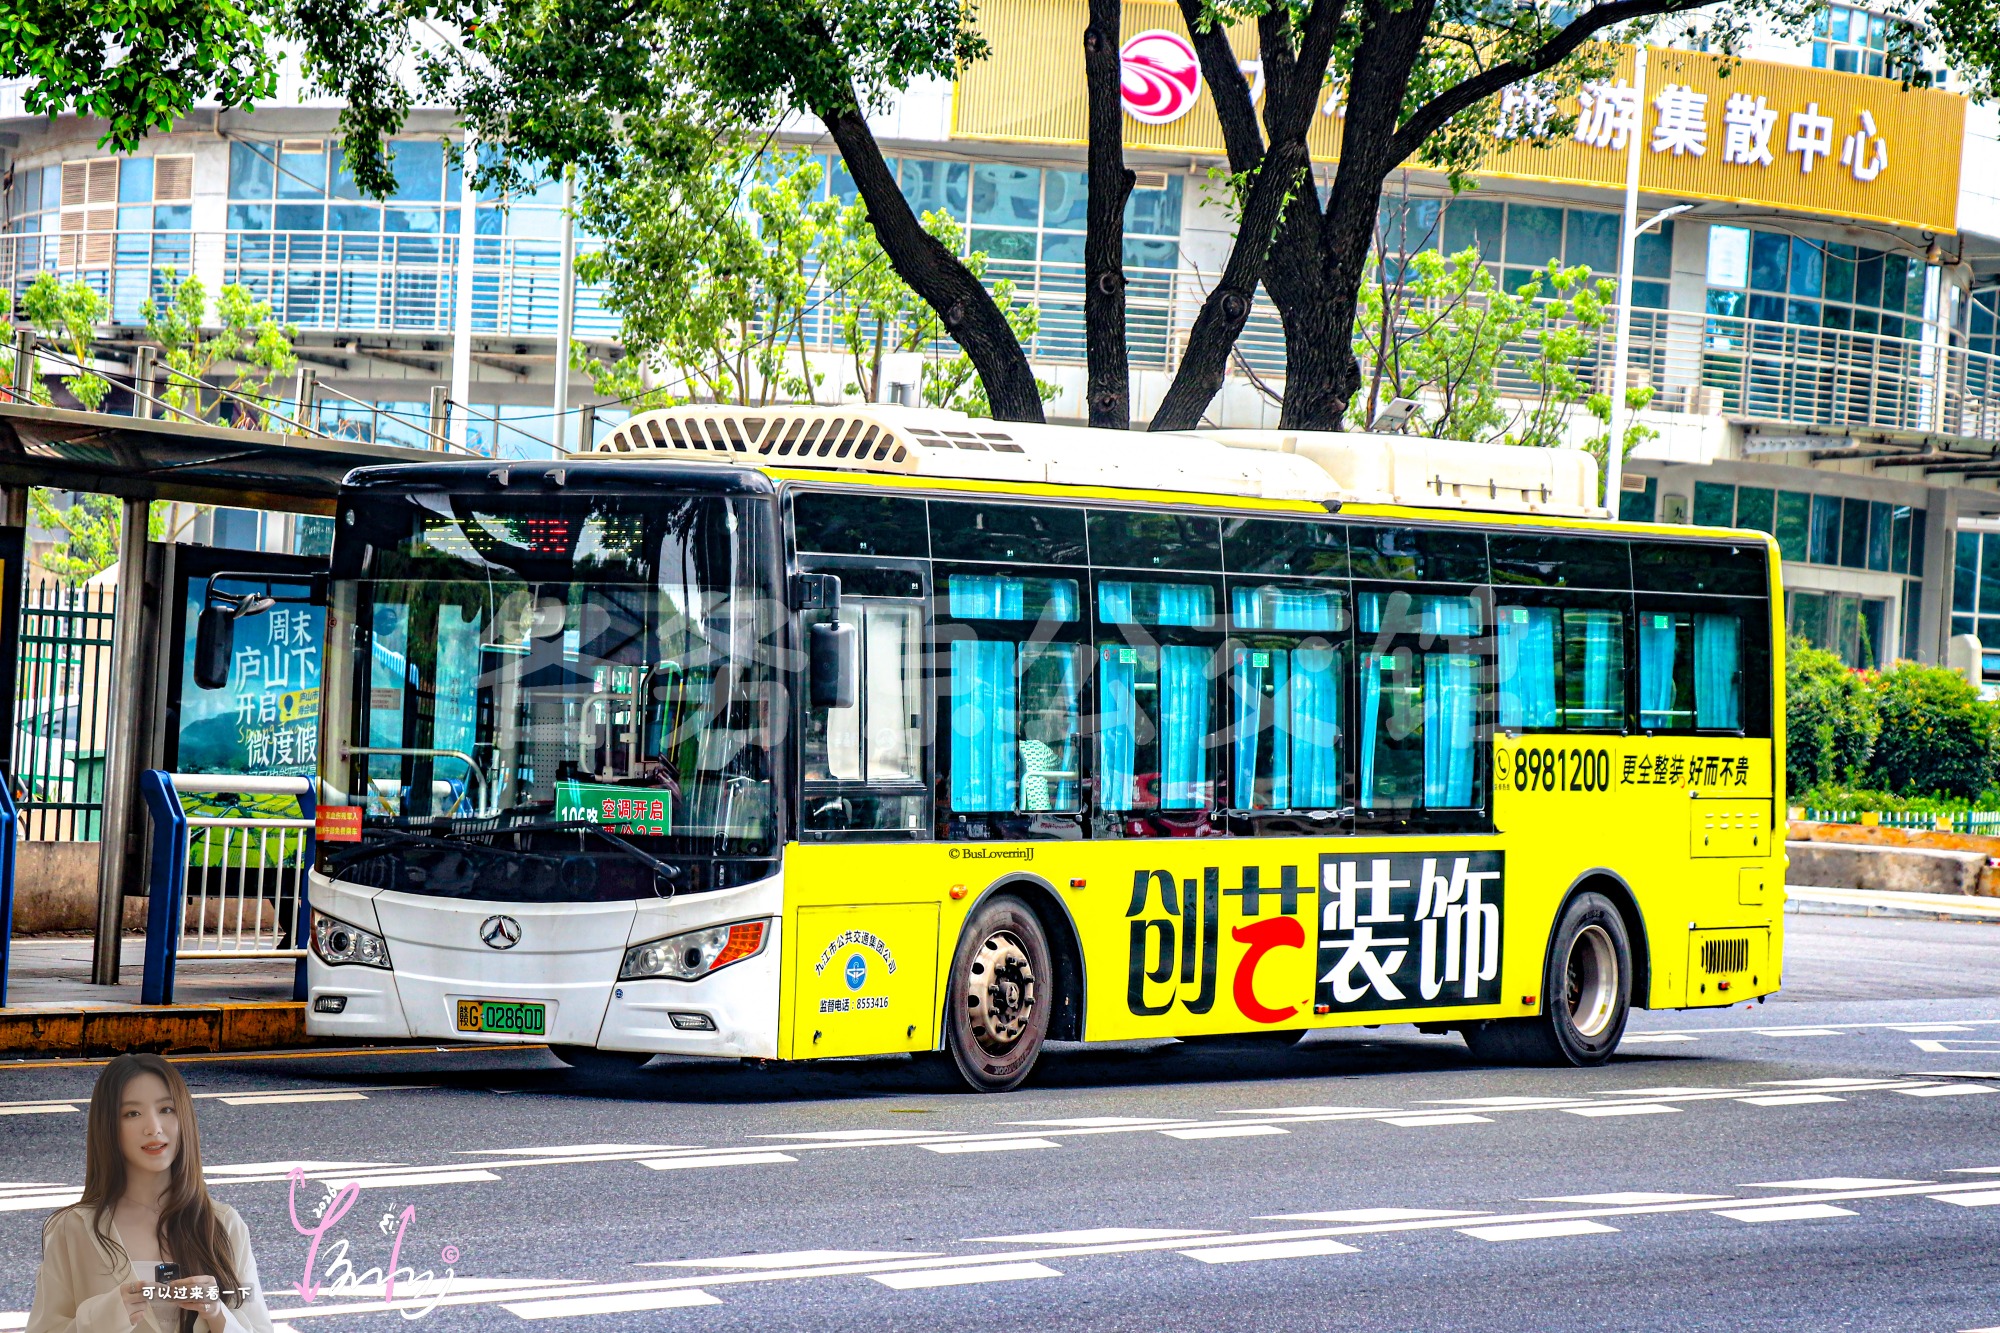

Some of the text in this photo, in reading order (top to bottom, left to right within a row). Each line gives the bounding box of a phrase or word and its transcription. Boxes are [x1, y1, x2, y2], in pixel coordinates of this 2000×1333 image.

[267, 608, 312, 646] 周末
[234, 645, 316, 692] 庐山下
[236, 691, 276, 725] 开启
[247, 725, 317, 767] 微度假
[1514, 748, 1749, 792] 8981200 更全整装 好而不贵
[602, 798, 663, 821] 空调开启
[815, 930, 897, 976] 九江市公共交通集团公司
